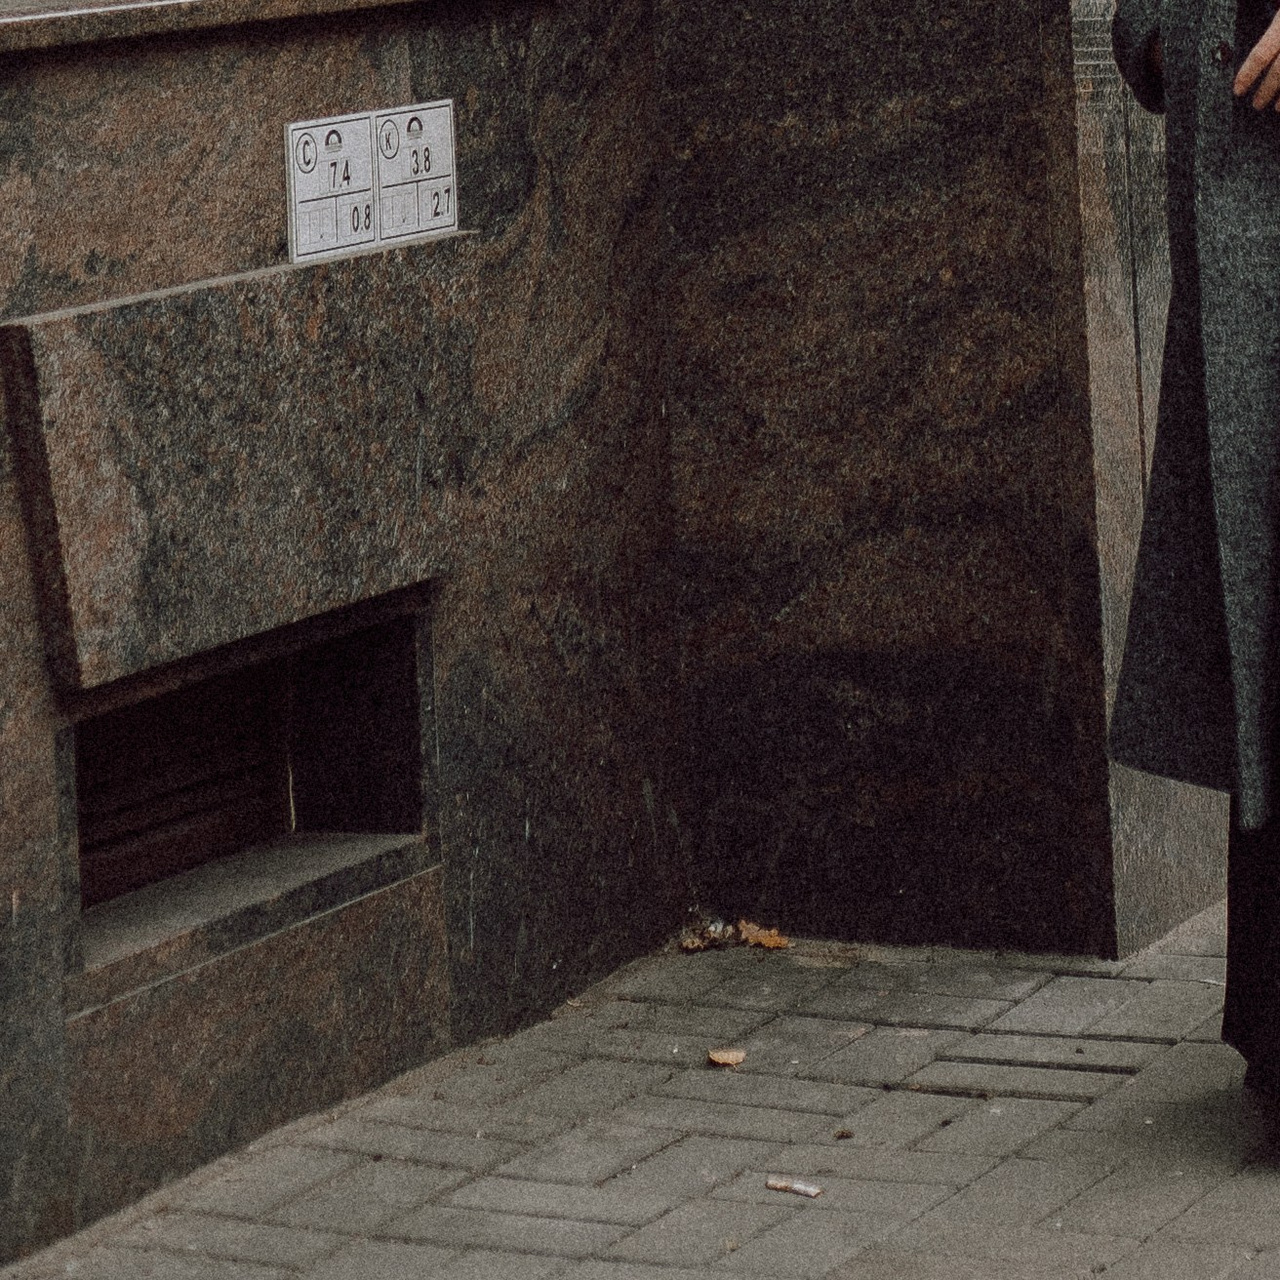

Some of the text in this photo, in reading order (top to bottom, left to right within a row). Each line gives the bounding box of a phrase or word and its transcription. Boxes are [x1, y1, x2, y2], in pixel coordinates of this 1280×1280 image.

[330, 159, 351, 189] 7.4
[411, 146, 431, 175] 3.8
[432, 187, 451, 218] 2.7
[351, 203, 371, 233] 0.8
